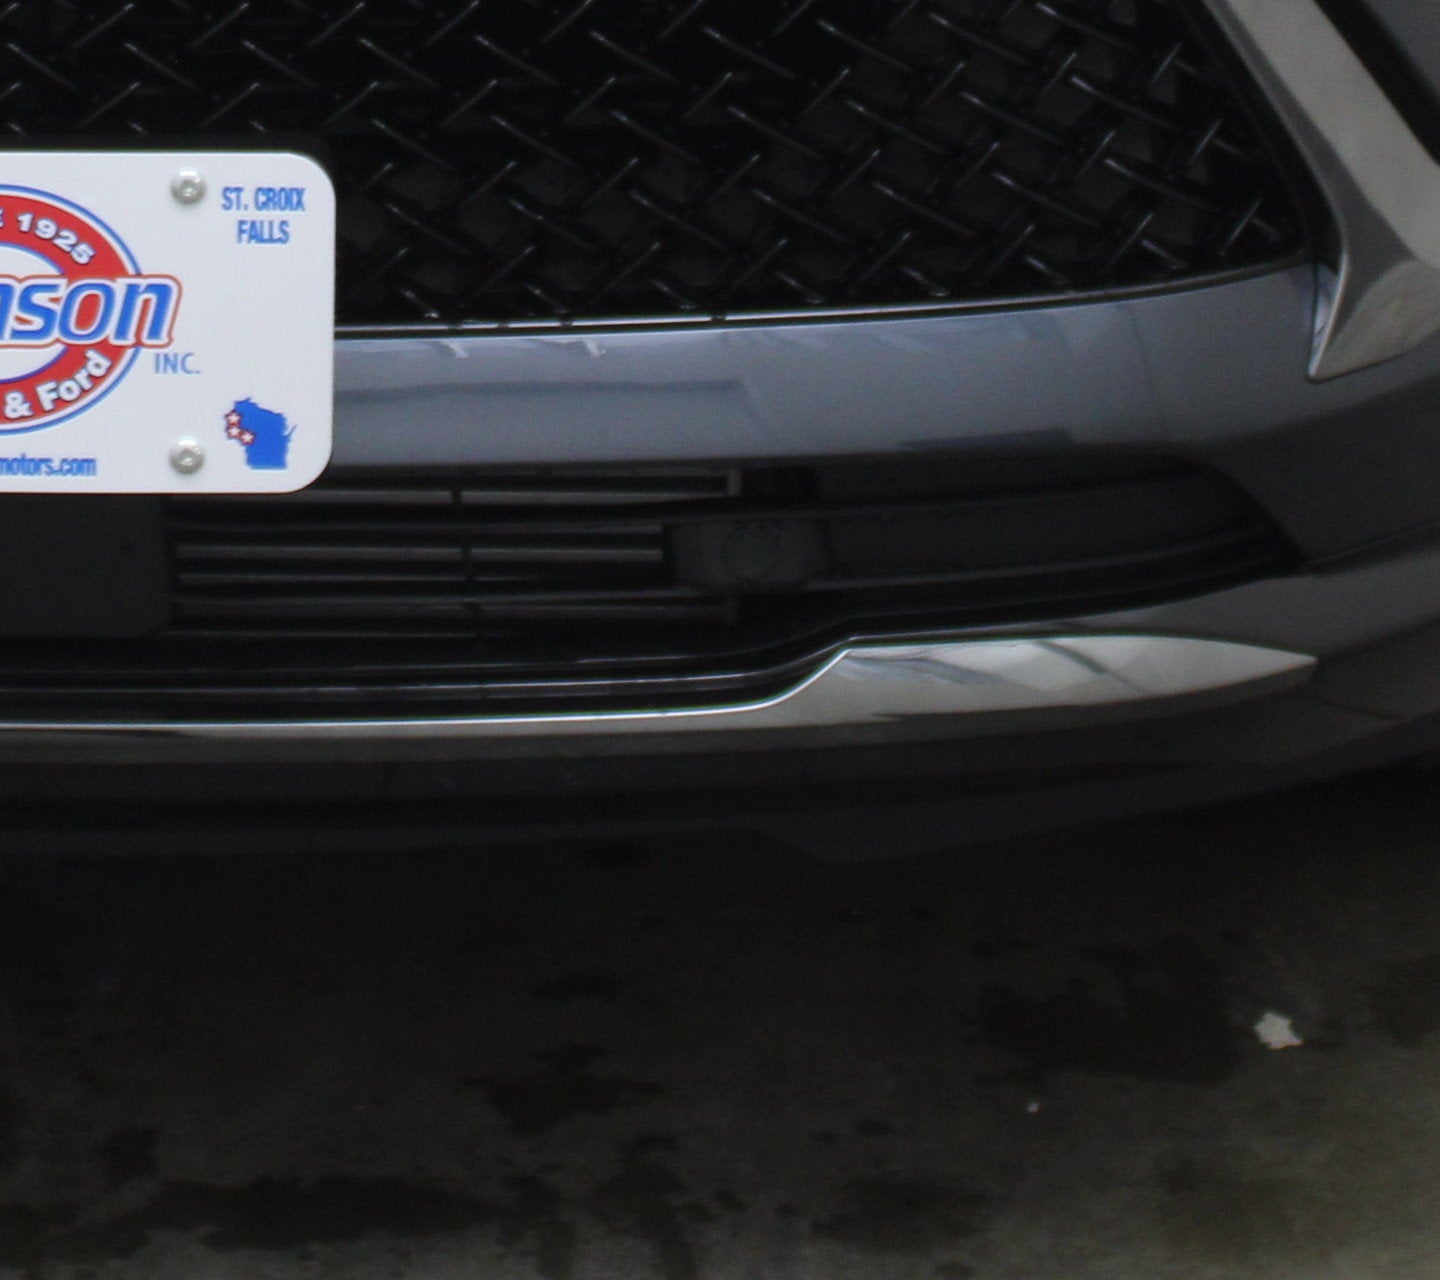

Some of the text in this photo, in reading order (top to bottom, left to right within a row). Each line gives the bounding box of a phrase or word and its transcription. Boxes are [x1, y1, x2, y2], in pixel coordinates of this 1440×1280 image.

[222, 186, 306, 212] ST. CROIX
[16, 212, 96, 266] 1925
[236, 219, 291, 245] FALLS
[154, 352, 202, 375] INC.
[3, 390, 34, 419] &
[34, 348, 113, 412] Ford
